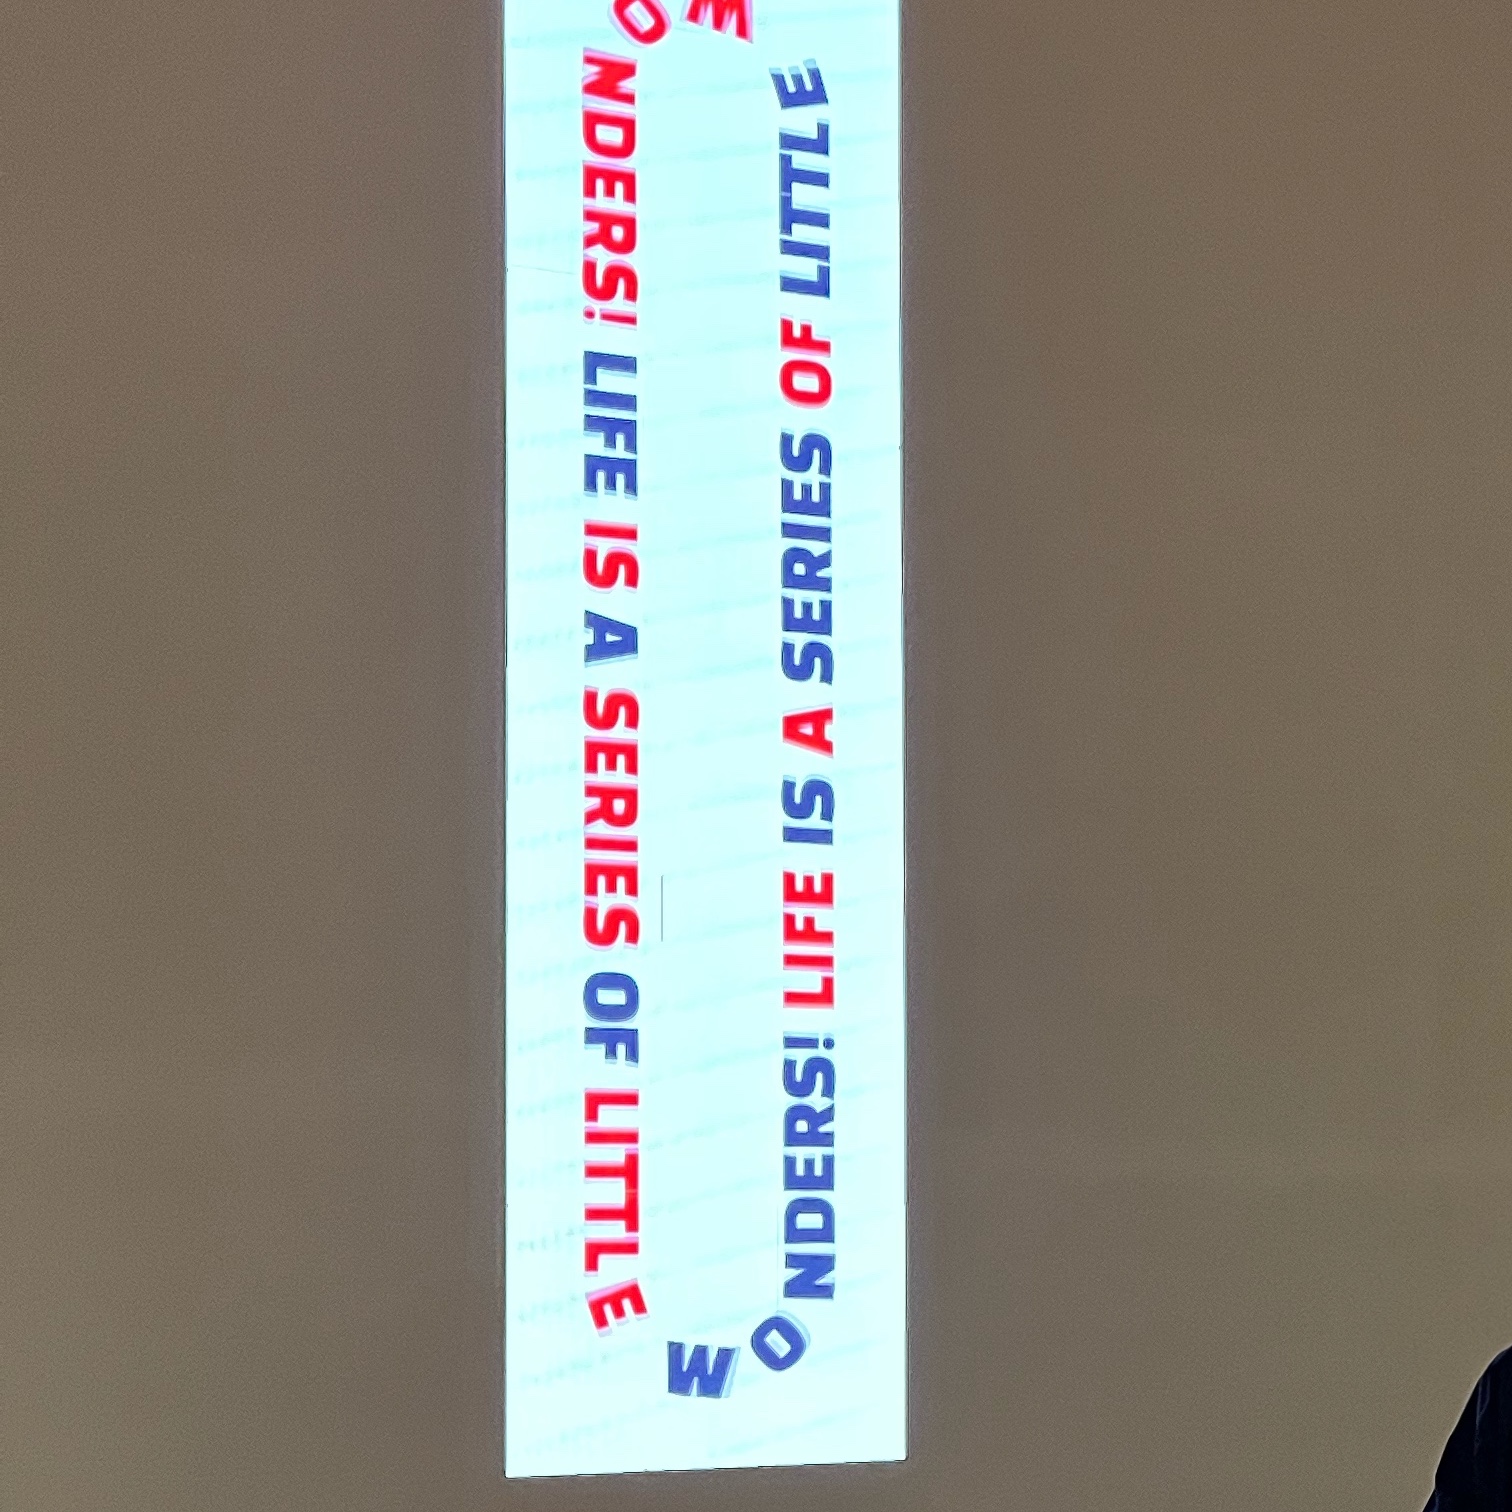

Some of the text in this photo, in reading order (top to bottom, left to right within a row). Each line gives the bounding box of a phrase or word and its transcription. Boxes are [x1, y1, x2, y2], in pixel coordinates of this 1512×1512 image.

[769, 59, 830, 299] LITTLE
[779, 314, 832, 407] OF
[584, 351, 637, 496] LIFE
[583, 520, 639, 591] IS
[781, 430, 835, 684] SERIES
[584, 610, 638, 667] A
[783, 704, 834, 758] A
[582, 687, 640, 950] SERIES
[782, 774, 835, 844] IS
[783, 870, 835, 1008] LIFE
[583, 971, 639, 1066] OF
[585, 1089, 648, 1336] LITTLE
